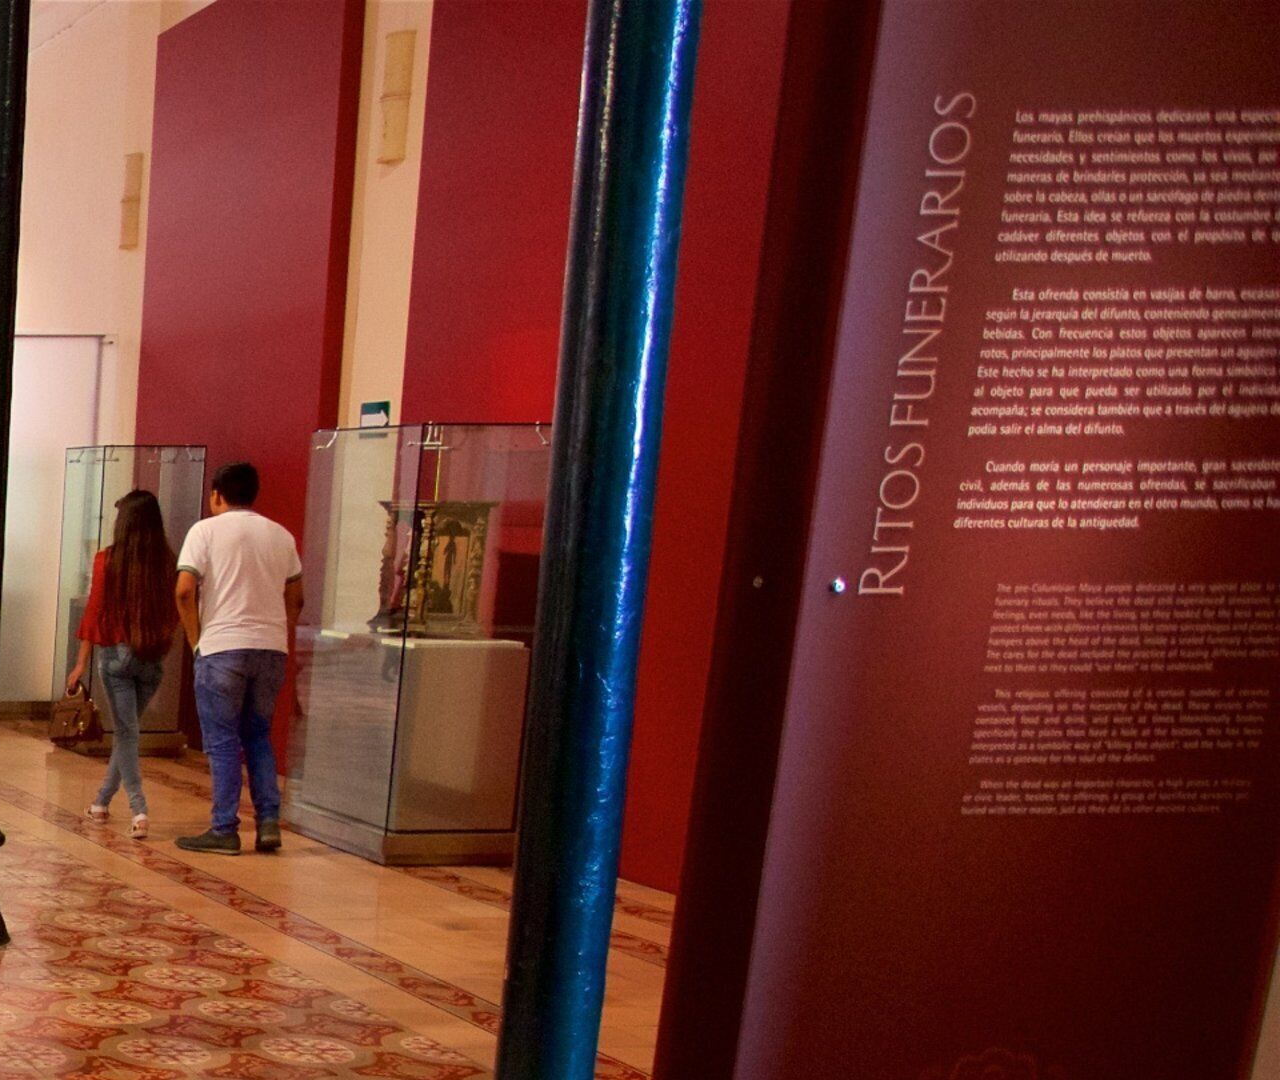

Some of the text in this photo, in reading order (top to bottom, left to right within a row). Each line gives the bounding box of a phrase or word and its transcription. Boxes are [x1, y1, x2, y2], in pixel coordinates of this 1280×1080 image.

[858, 91, 977, 595] RITOS FUNERARIOS
[967, 422, 1125, 437] podía salir el alma del difunto.
[953, 516, 1005, 527] diferentes
[1007, 516, 1050, 527] culturas
[1051, 516, 1064, 527] de
[1066, 516, 1078, 527] la
